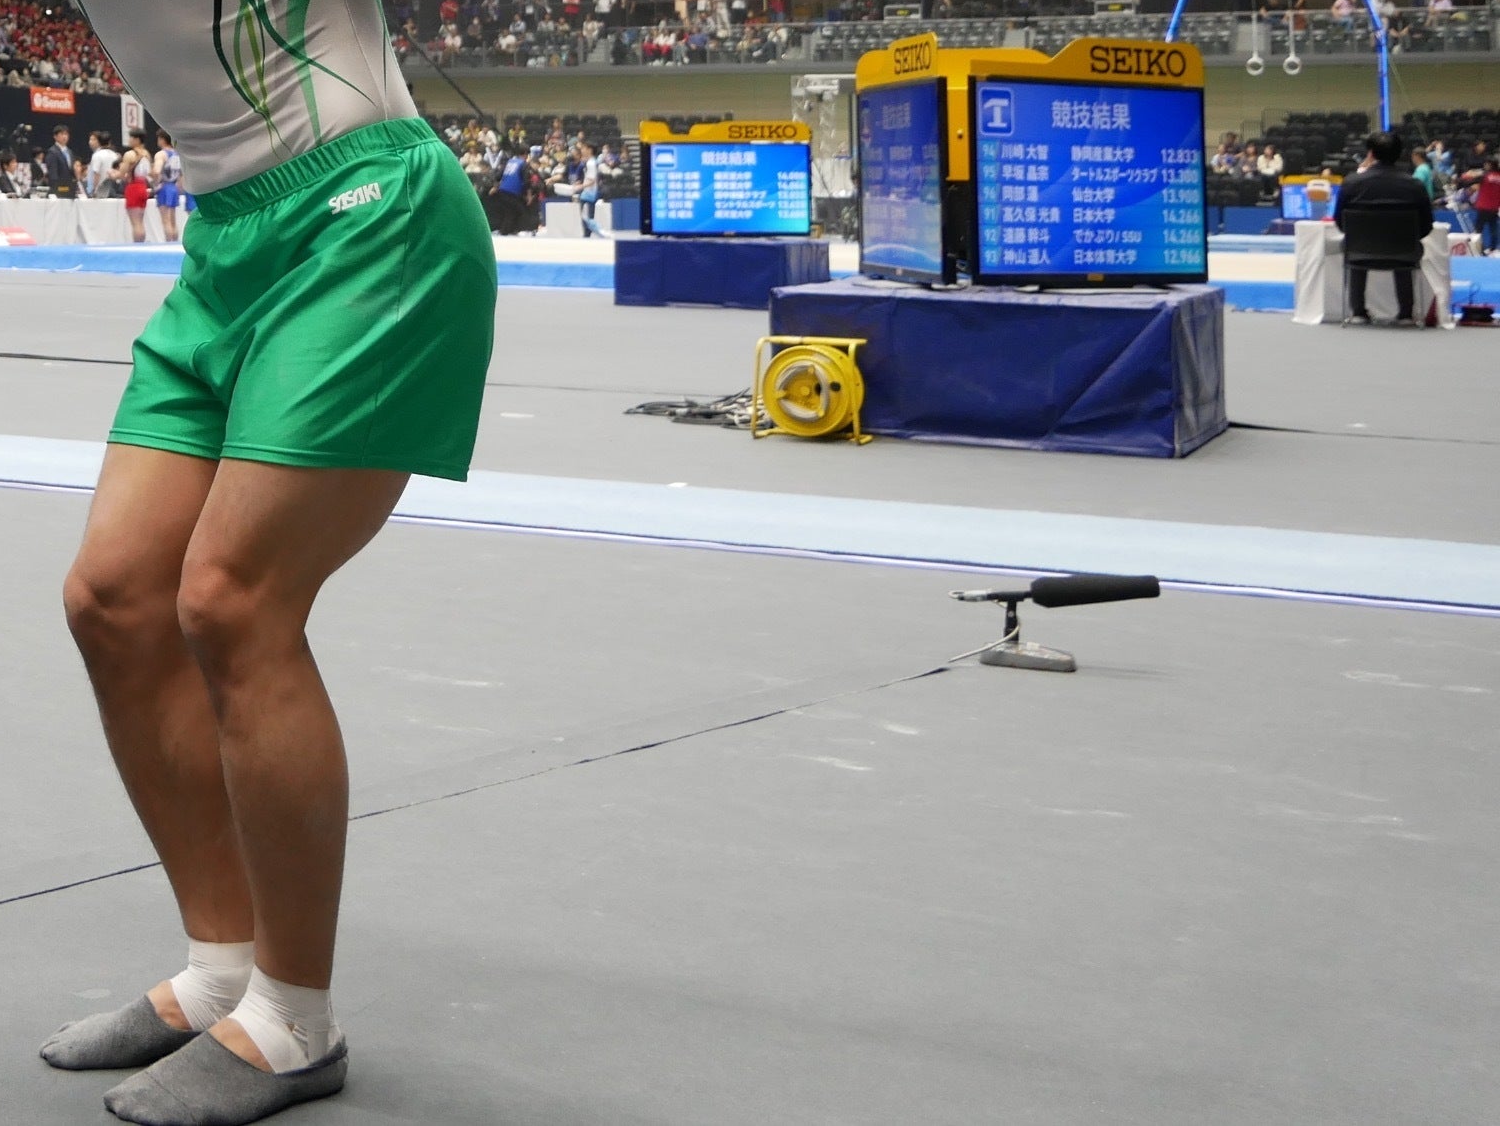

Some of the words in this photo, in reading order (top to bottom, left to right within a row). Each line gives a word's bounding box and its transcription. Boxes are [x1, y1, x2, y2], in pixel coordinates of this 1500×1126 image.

[894, 41, 931, 75] SEIKO
[1090, 45, 1186, 77] SEIKO
[1051, 100, 1131, 130] 競技結果
[728, 125, 798, 139] SEIKO
[328, 182, 382, 215] SASAKI
[1073, 207, 1116, 224] 日本大学
[1074, 249, 1137, 265] 日本体育大学
